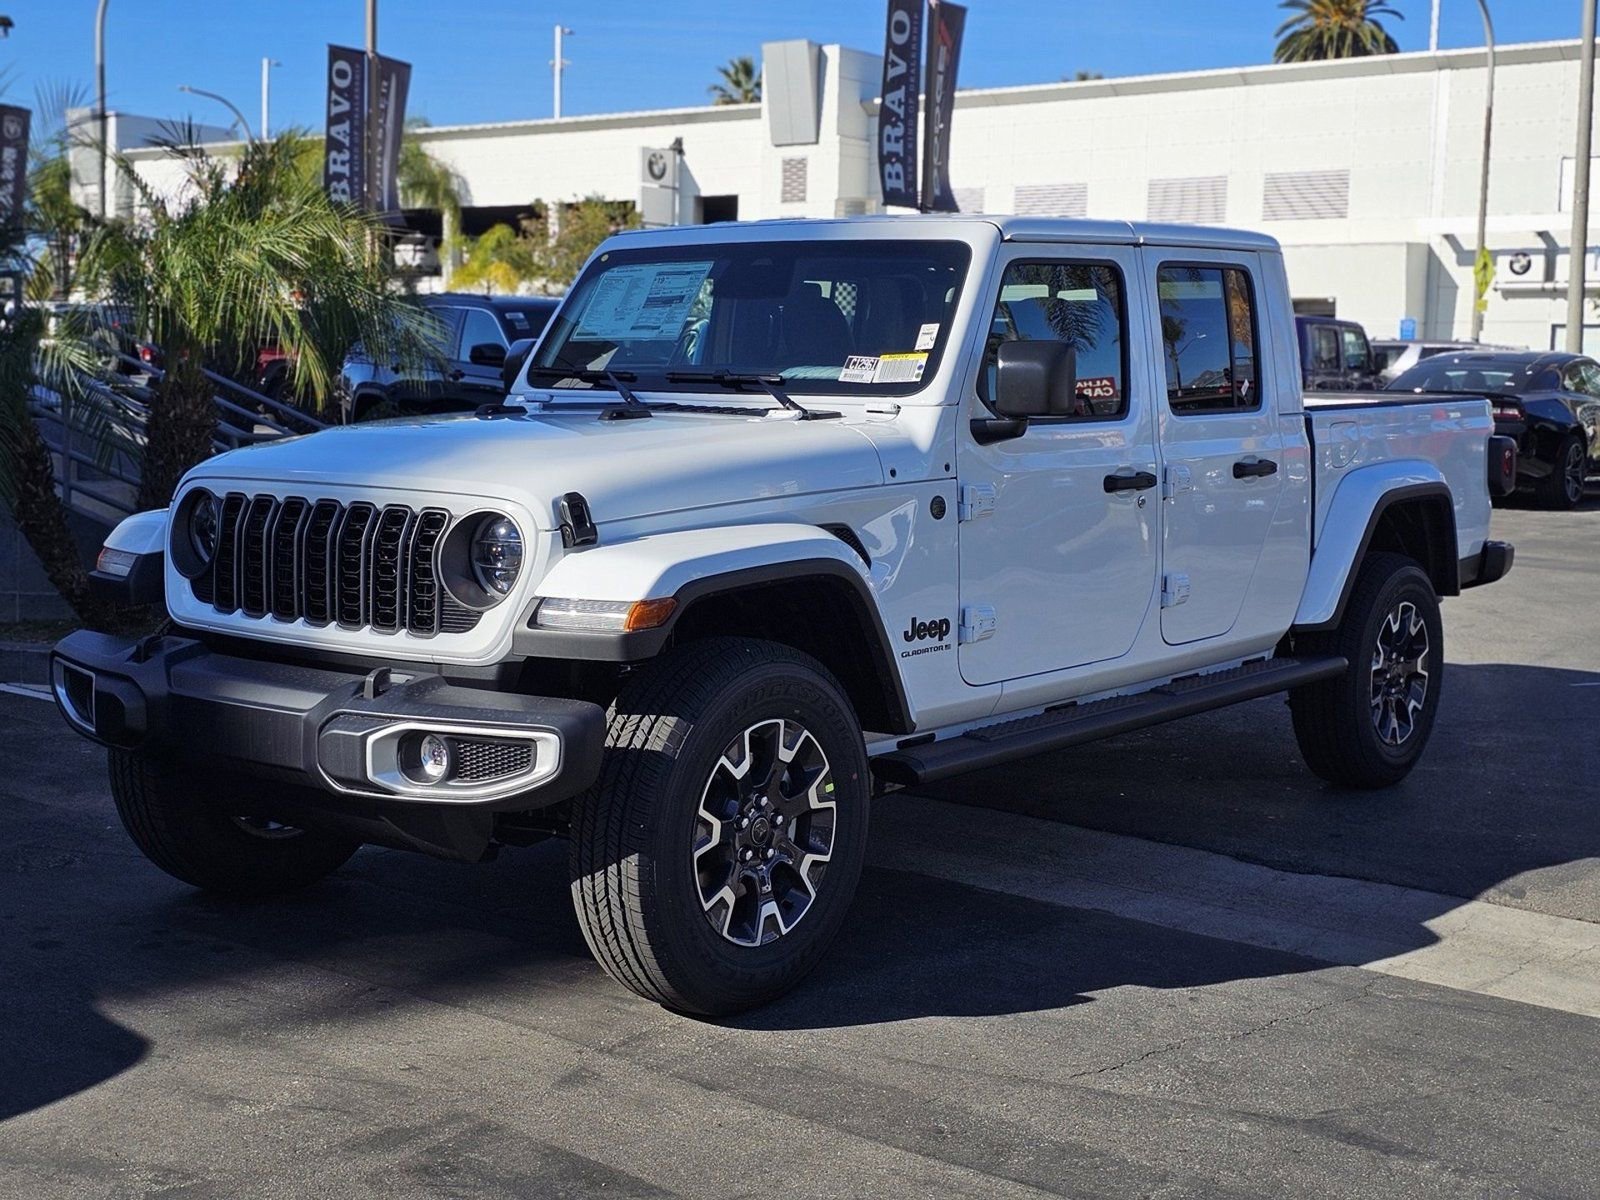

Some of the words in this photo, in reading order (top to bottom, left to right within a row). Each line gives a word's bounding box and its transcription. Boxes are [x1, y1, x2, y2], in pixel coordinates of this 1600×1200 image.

[909, 12, 919, 92] DEALERSHIP
[329, 59, 352, 203] BRAVO
[377, 80, 388, 201] CHRYSLER
[884, 10, 910, 192] BRAVO
[907, 119, 915, 149] KIND
[908, 97, 915, 113] OF
[932, 45, 947, 196] DODGE
[900, 644, 944, 658] GLADIATOR
[903, 616, 951, 643] Jeep
